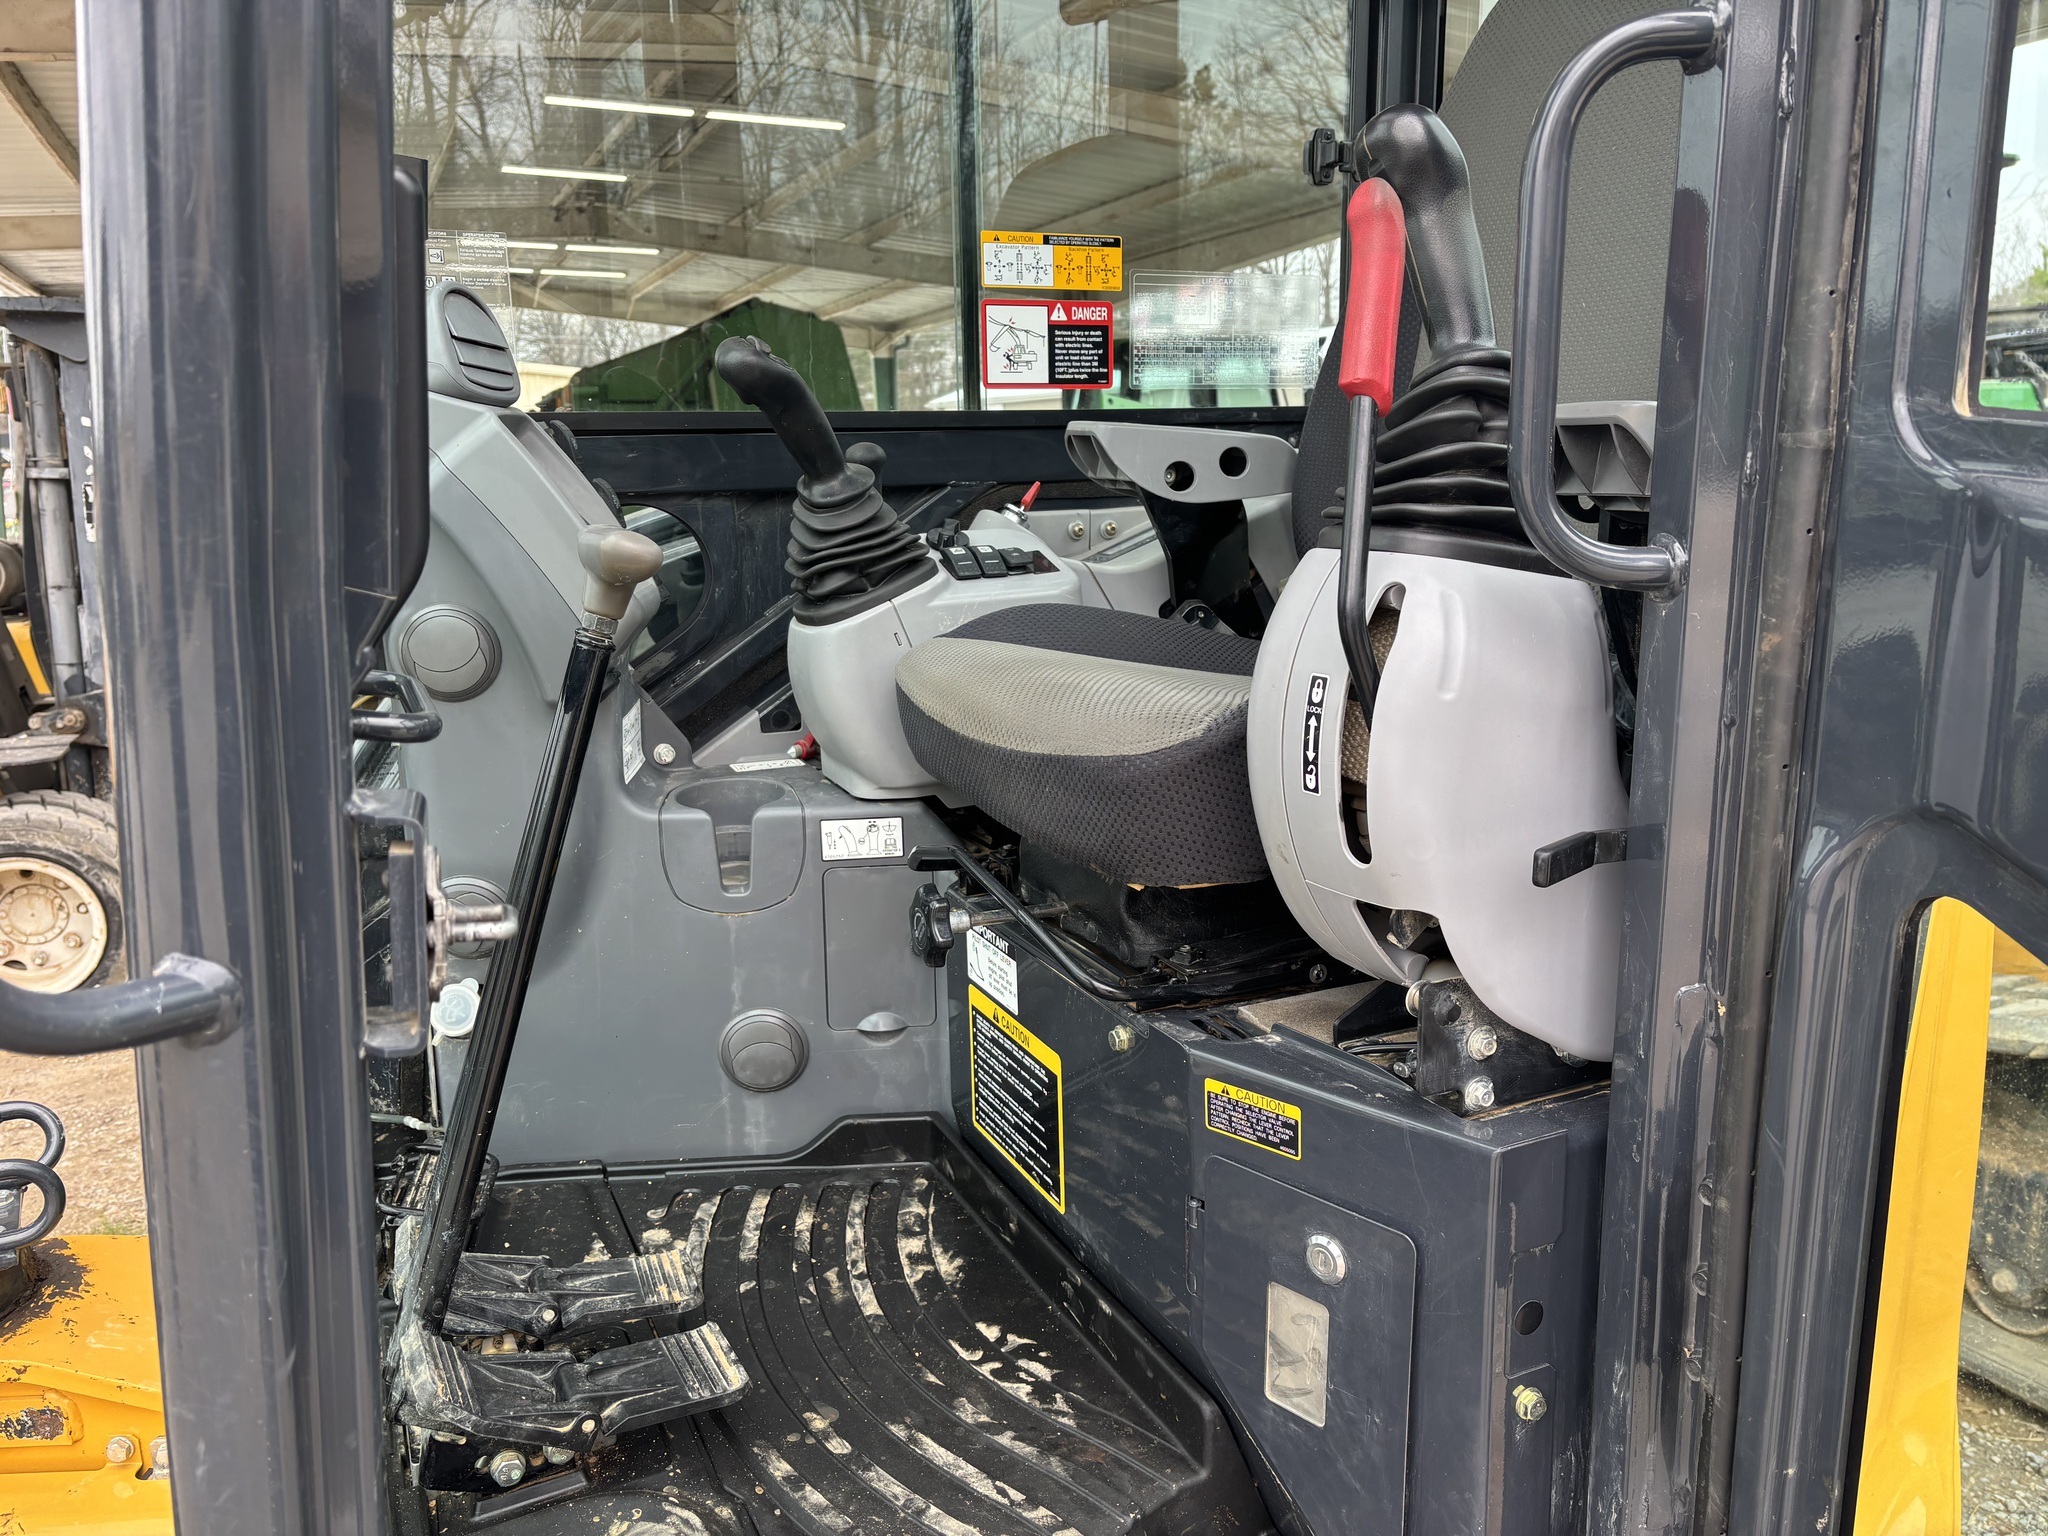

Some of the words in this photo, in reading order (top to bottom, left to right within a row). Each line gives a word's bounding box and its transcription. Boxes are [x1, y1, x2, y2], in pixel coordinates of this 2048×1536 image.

[1007, 234, 1034, 242] CAUTION
[1219, 278, 1254, 286] CAPACITY
[1072, 306, 1108, 321] DANGER
[1306, 705, 1322, 714] LOCK
[972, 934, 981, 944] PILOT
[1000, 953, 1012, 967] LEVER
[973, 926, 1009, 954] PORTANT
[1001, 1016, 1030, 1048] CAUTION
[1211, 1099, 1233, 1109] OPERATING
[1246, 1110, 1266, 1121] SELECTOR
[1236, 1089, 1286, 1114] CAUTION
[1211, 1121, 1235, 1132] CORRECTLY
[1225, 1110, 1247, 1120] CHANGING
[1259, 1120, 1272, 1129] LEVER
[1274, 1125, 1294, 1136] CONTROL
[1261, 1109, 1276, 1118] ENGINE
[1279, 1115, 1296, 1125] BEFORE
[1211, 1116, 1229, 1126] CONTROL
[1232, 1123, 1254, 1133] POSITIONS
[1255, 1130, 1266, 1138] HAVE
[1269, 1135, 1280, 1143] BEEN
[1232, 1117, 1251, 1127] RECHECK
[1276, 1132, 1290, 1140] LEVER
